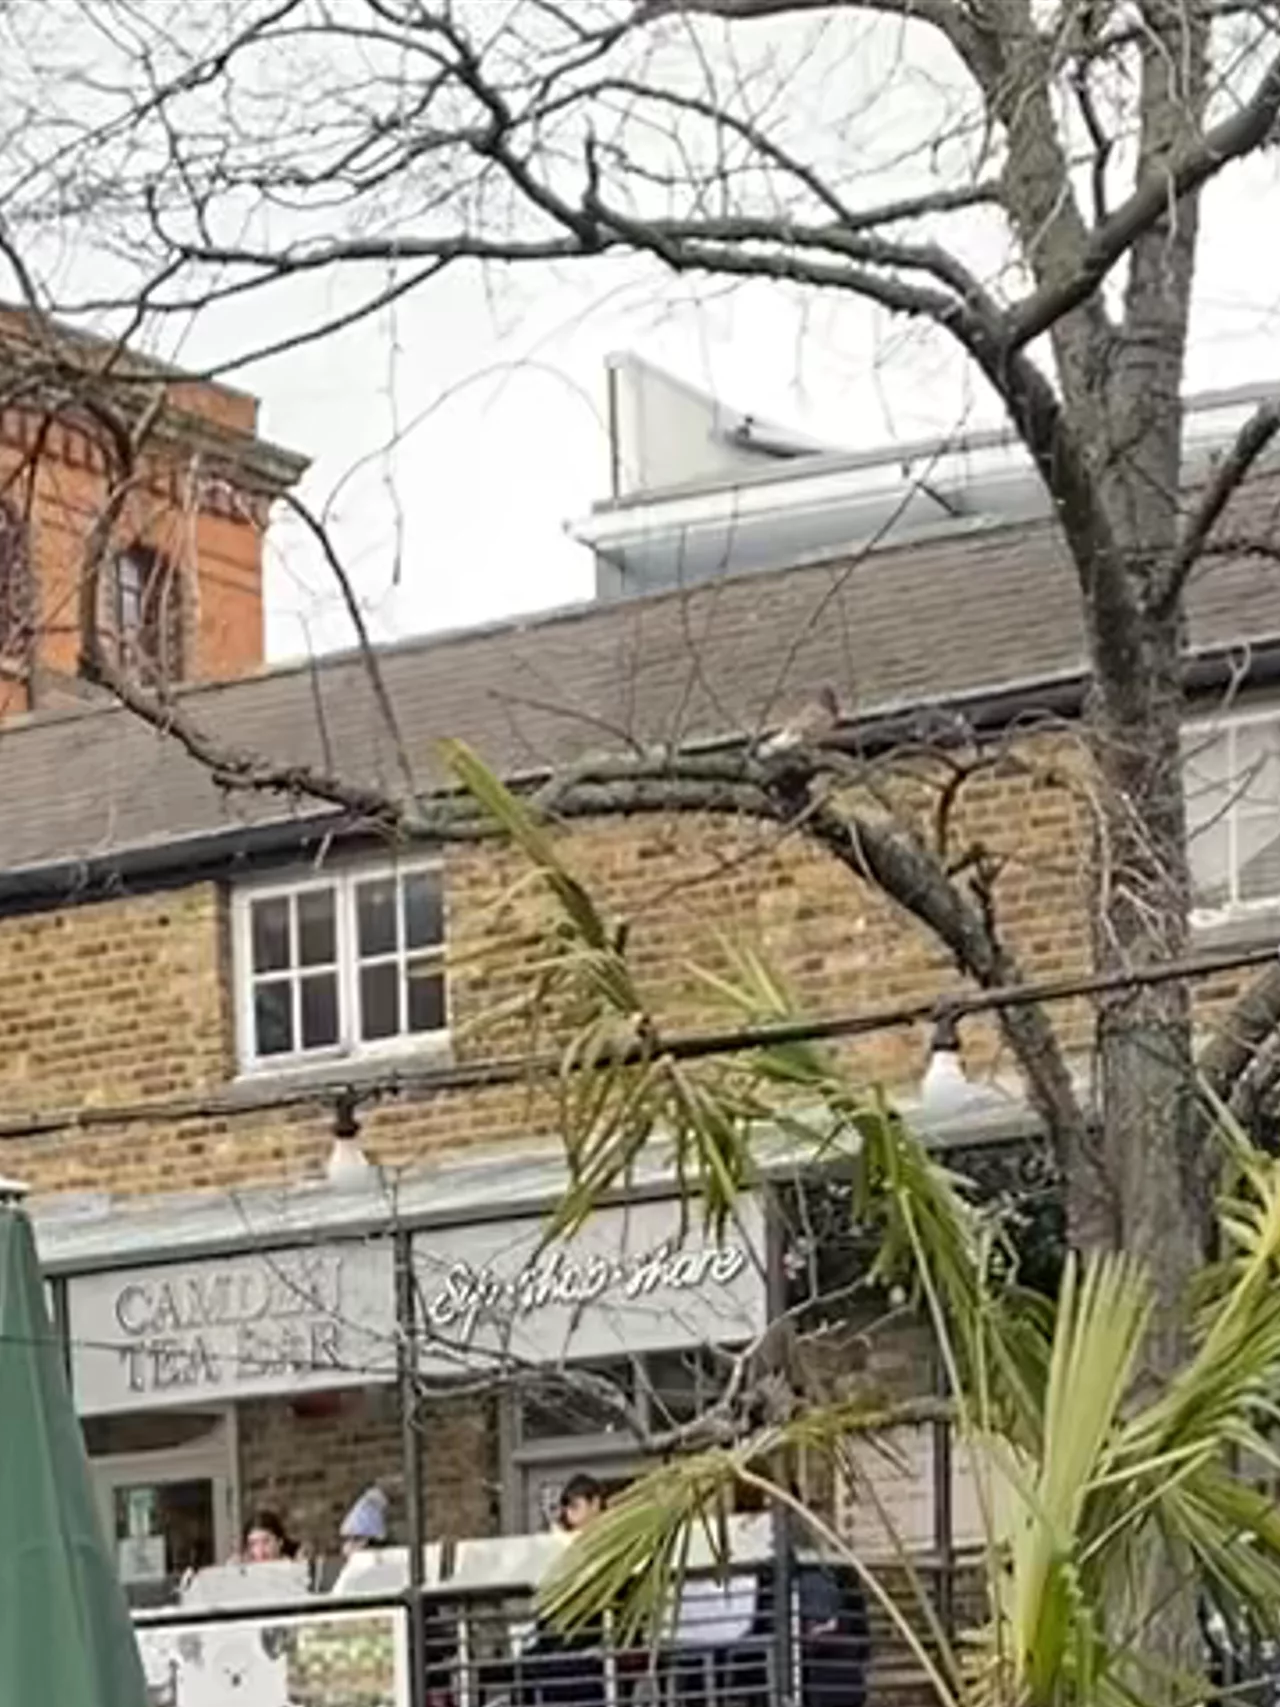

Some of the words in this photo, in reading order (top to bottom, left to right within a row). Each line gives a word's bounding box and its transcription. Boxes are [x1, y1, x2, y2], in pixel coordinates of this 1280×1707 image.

[115, 1256, 342, 1337] CAMDEN
[122, 1332, 220, 1392] TEA
[236, 1321, 350, 1379] BAR
